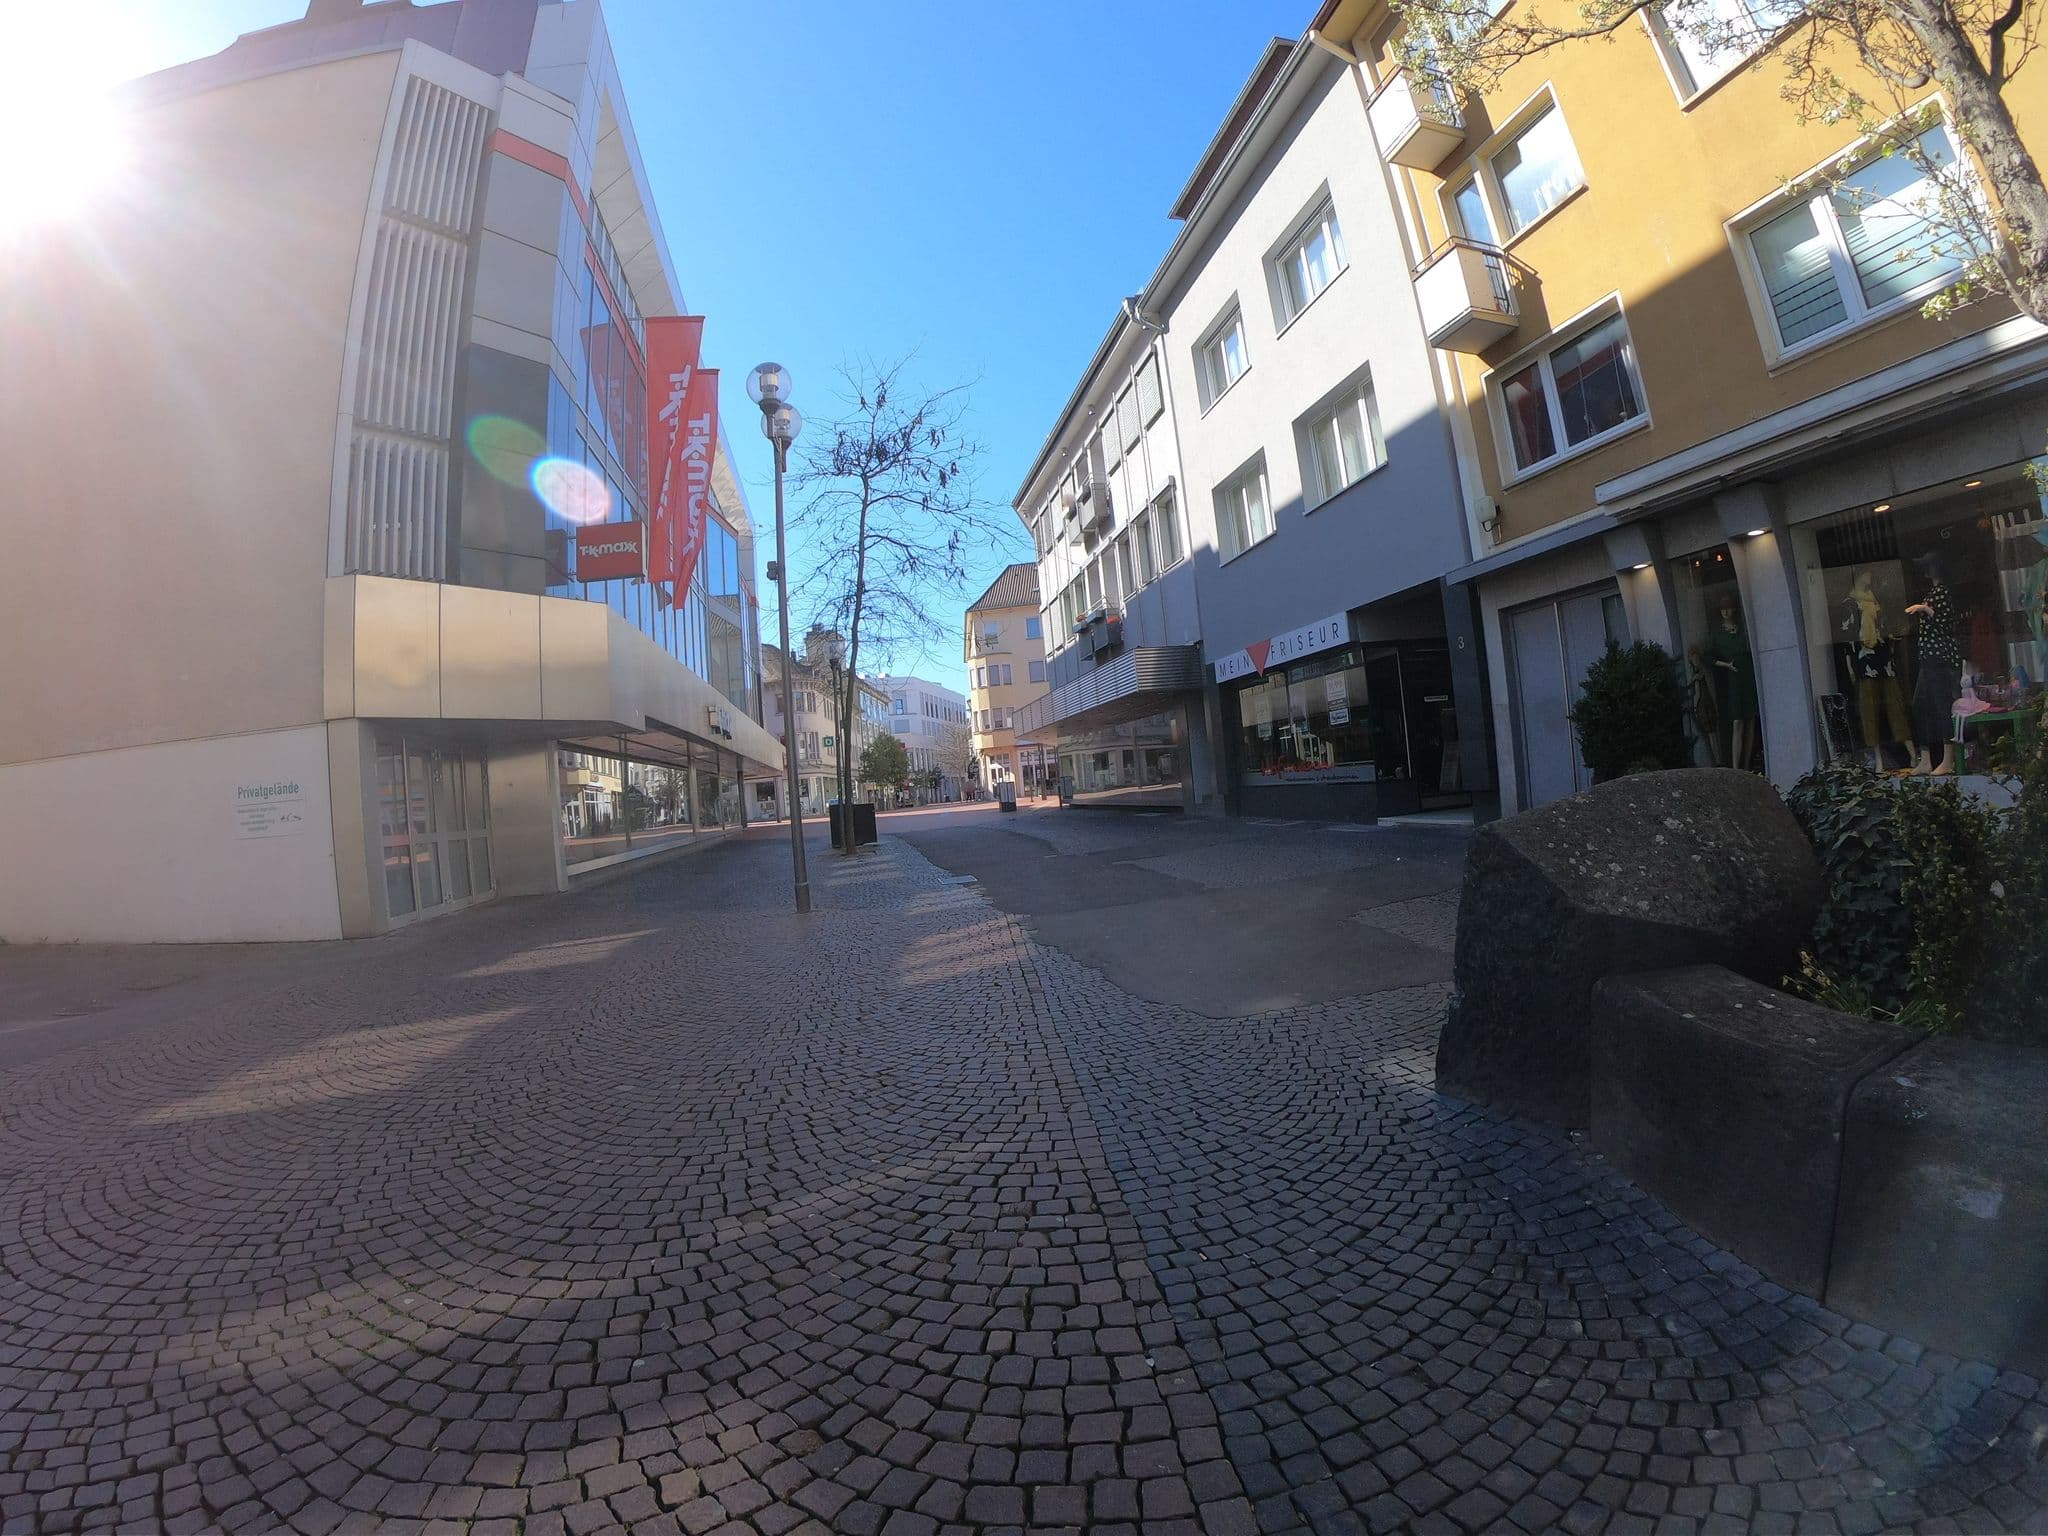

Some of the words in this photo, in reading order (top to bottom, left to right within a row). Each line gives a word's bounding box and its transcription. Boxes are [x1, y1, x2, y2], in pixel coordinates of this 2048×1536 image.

[1218, 653, 1250, 678] MEIN
[1270, 622, 1340, 660] FRISEUR
[1457, 635, 1465, 649] 3
[237, 781, 299, 799] Privatgelände
